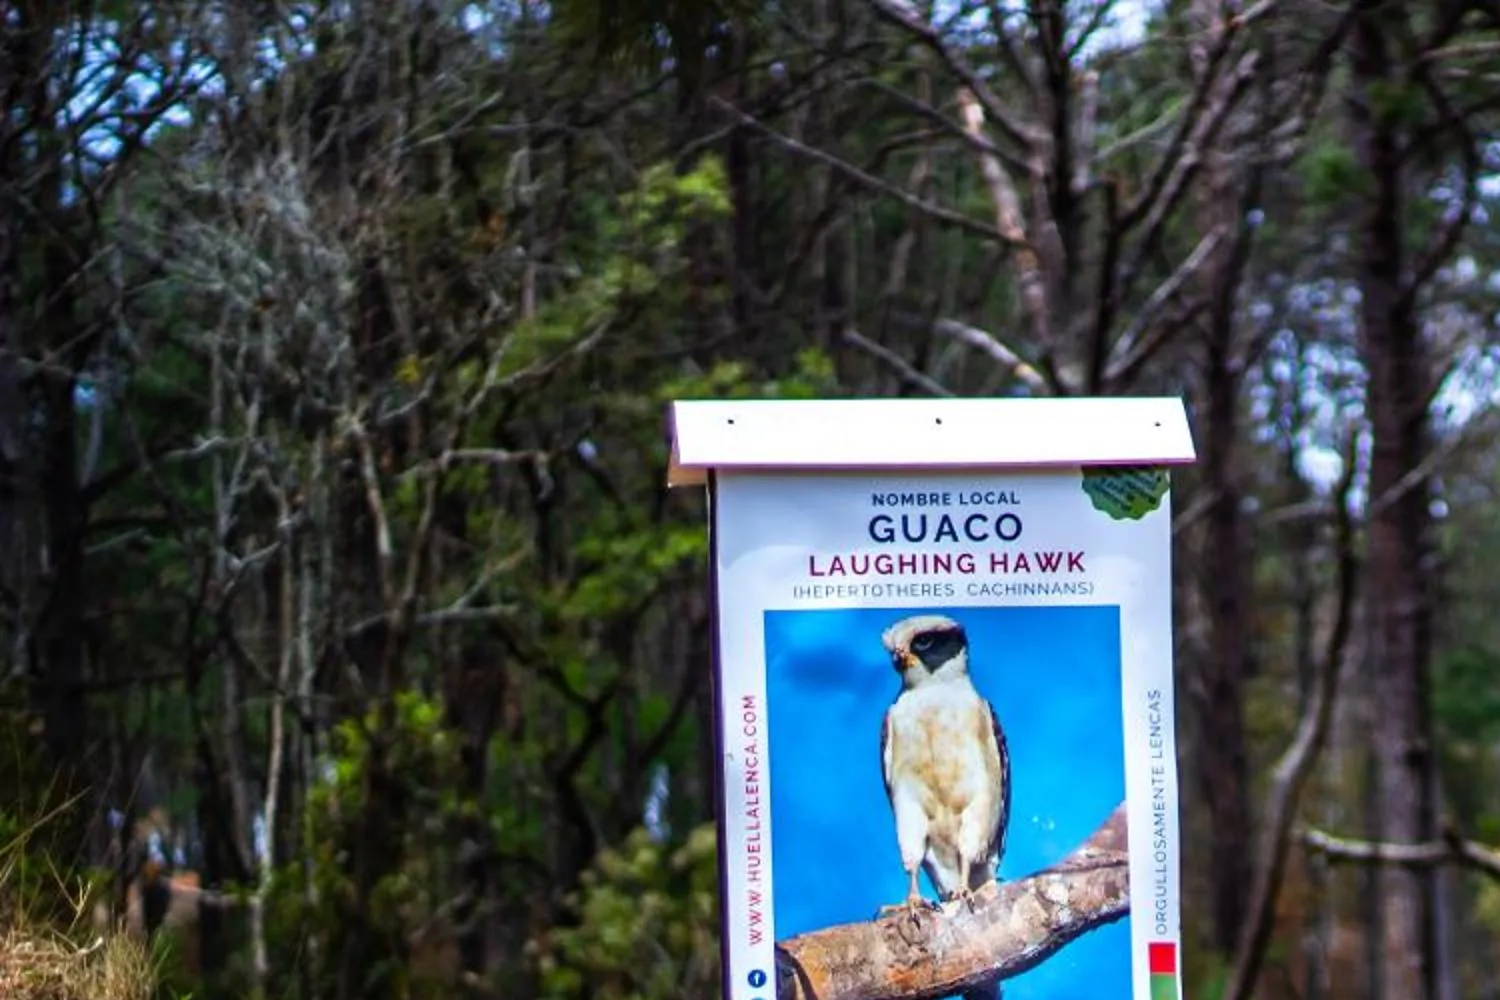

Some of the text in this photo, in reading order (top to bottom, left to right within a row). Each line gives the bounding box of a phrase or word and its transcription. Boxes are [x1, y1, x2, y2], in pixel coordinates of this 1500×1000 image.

[872, 491, 1021, 507] NOMBRE LOCAL
[868, 512, 1023, 543] GUACO
[809, 551, 1086, 577] LAUGHING HAWK
[742, 694, 763, 945] WWW.HUELLALENCA.COM
[1147, 688, 1169, 936] ORGULLOSAMENTE LENCAS
